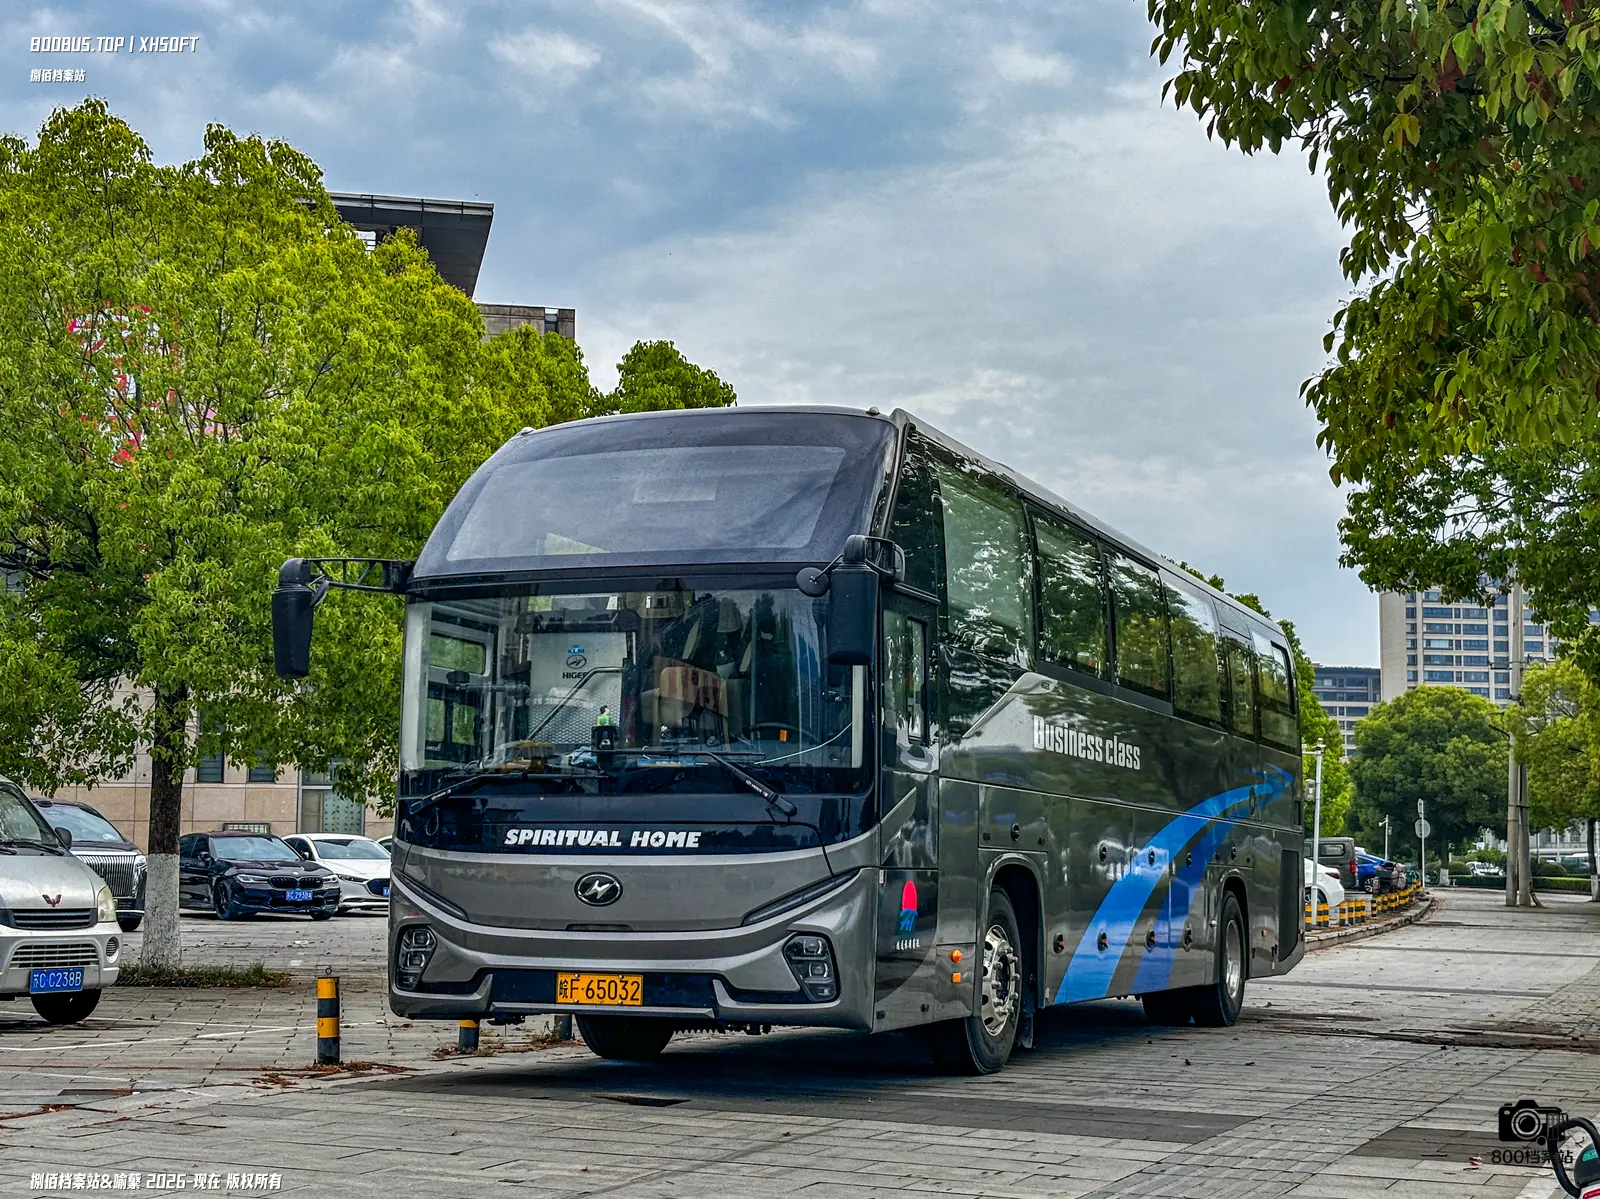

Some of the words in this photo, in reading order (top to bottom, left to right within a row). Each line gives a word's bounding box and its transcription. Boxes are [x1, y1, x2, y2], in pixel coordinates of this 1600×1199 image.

[1033, 714, 1103, 762] Business
[1105, 735, 1141, 770] class
[504, 828, 622, 847] SPIRITUAL
[630, 831, 701, 848] HOME
